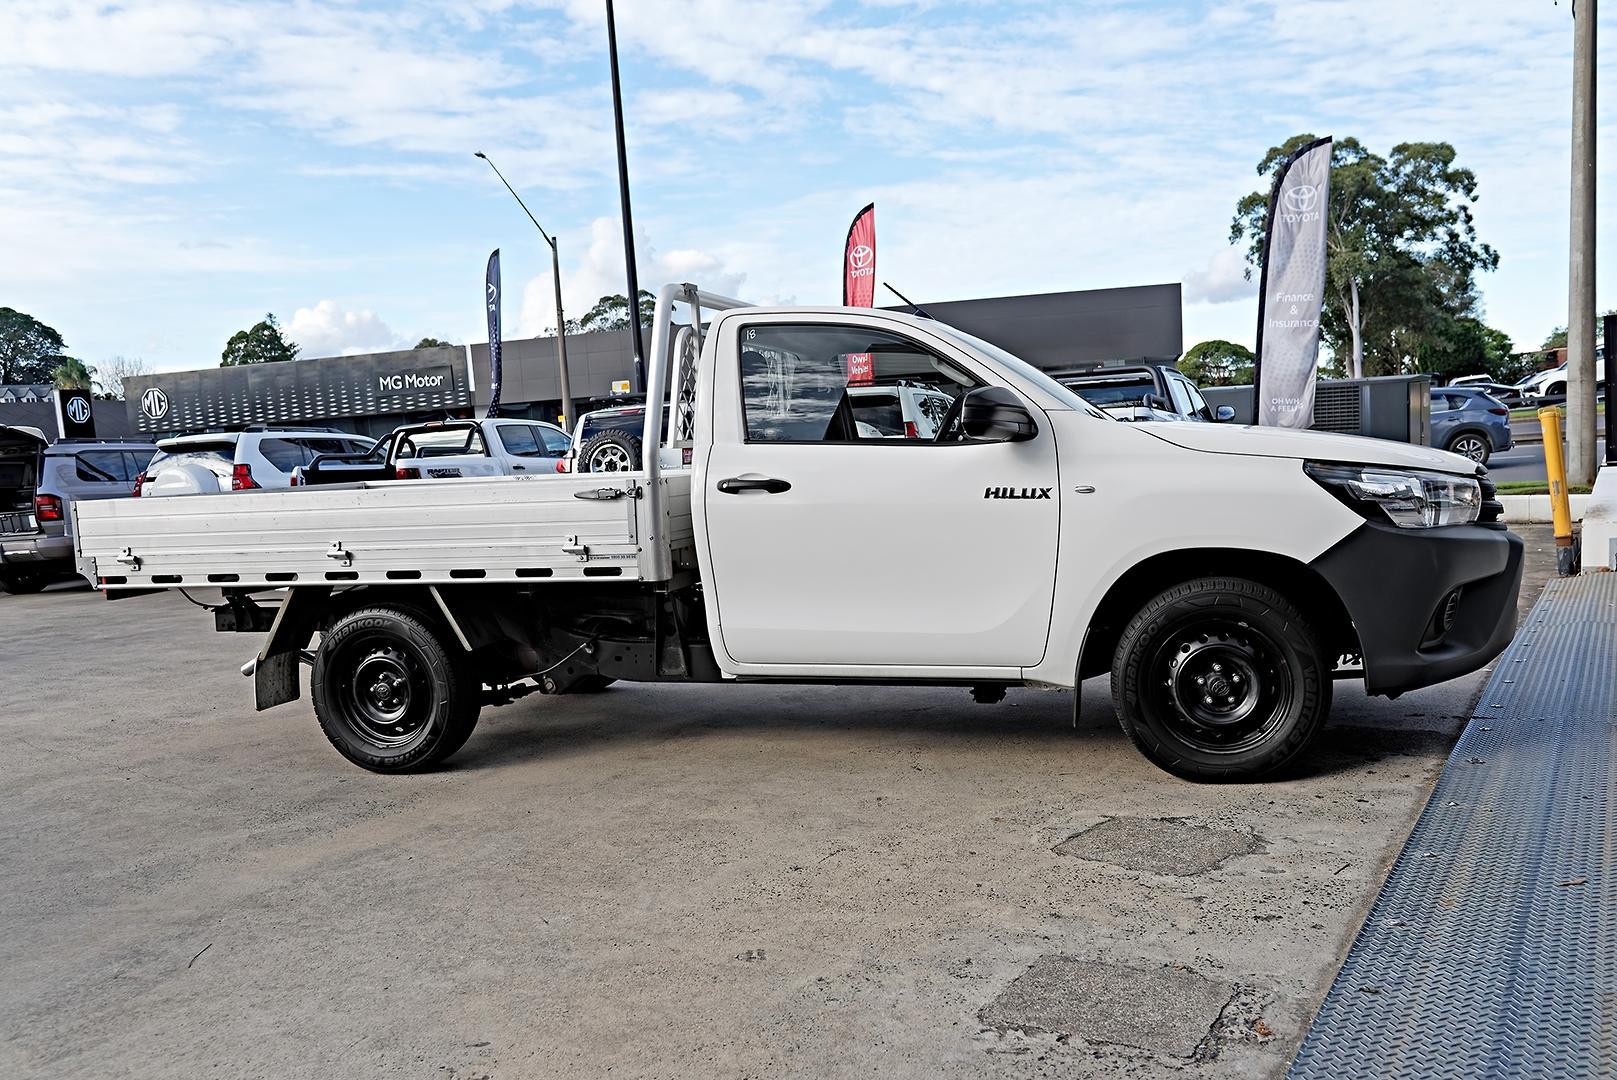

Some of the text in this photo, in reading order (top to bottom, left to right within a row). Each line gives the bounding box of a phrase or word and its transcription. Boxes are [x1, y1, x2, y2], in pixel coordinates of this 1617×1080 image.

[1281, 211, 1320, 223] TOYOTA
[1276, 291, 1314, 303] Finance
[1290, 304, 1298, 315] &
[1268, 318, 1319, 328] Insurance
[746, 329, 757, 341] 18
[379, 373, 444, 391] MG Motor
[143, 389, 167, 417] MG
[67, 398, 90, 422] MG
[984, 487, 1053, 499] HILUX
